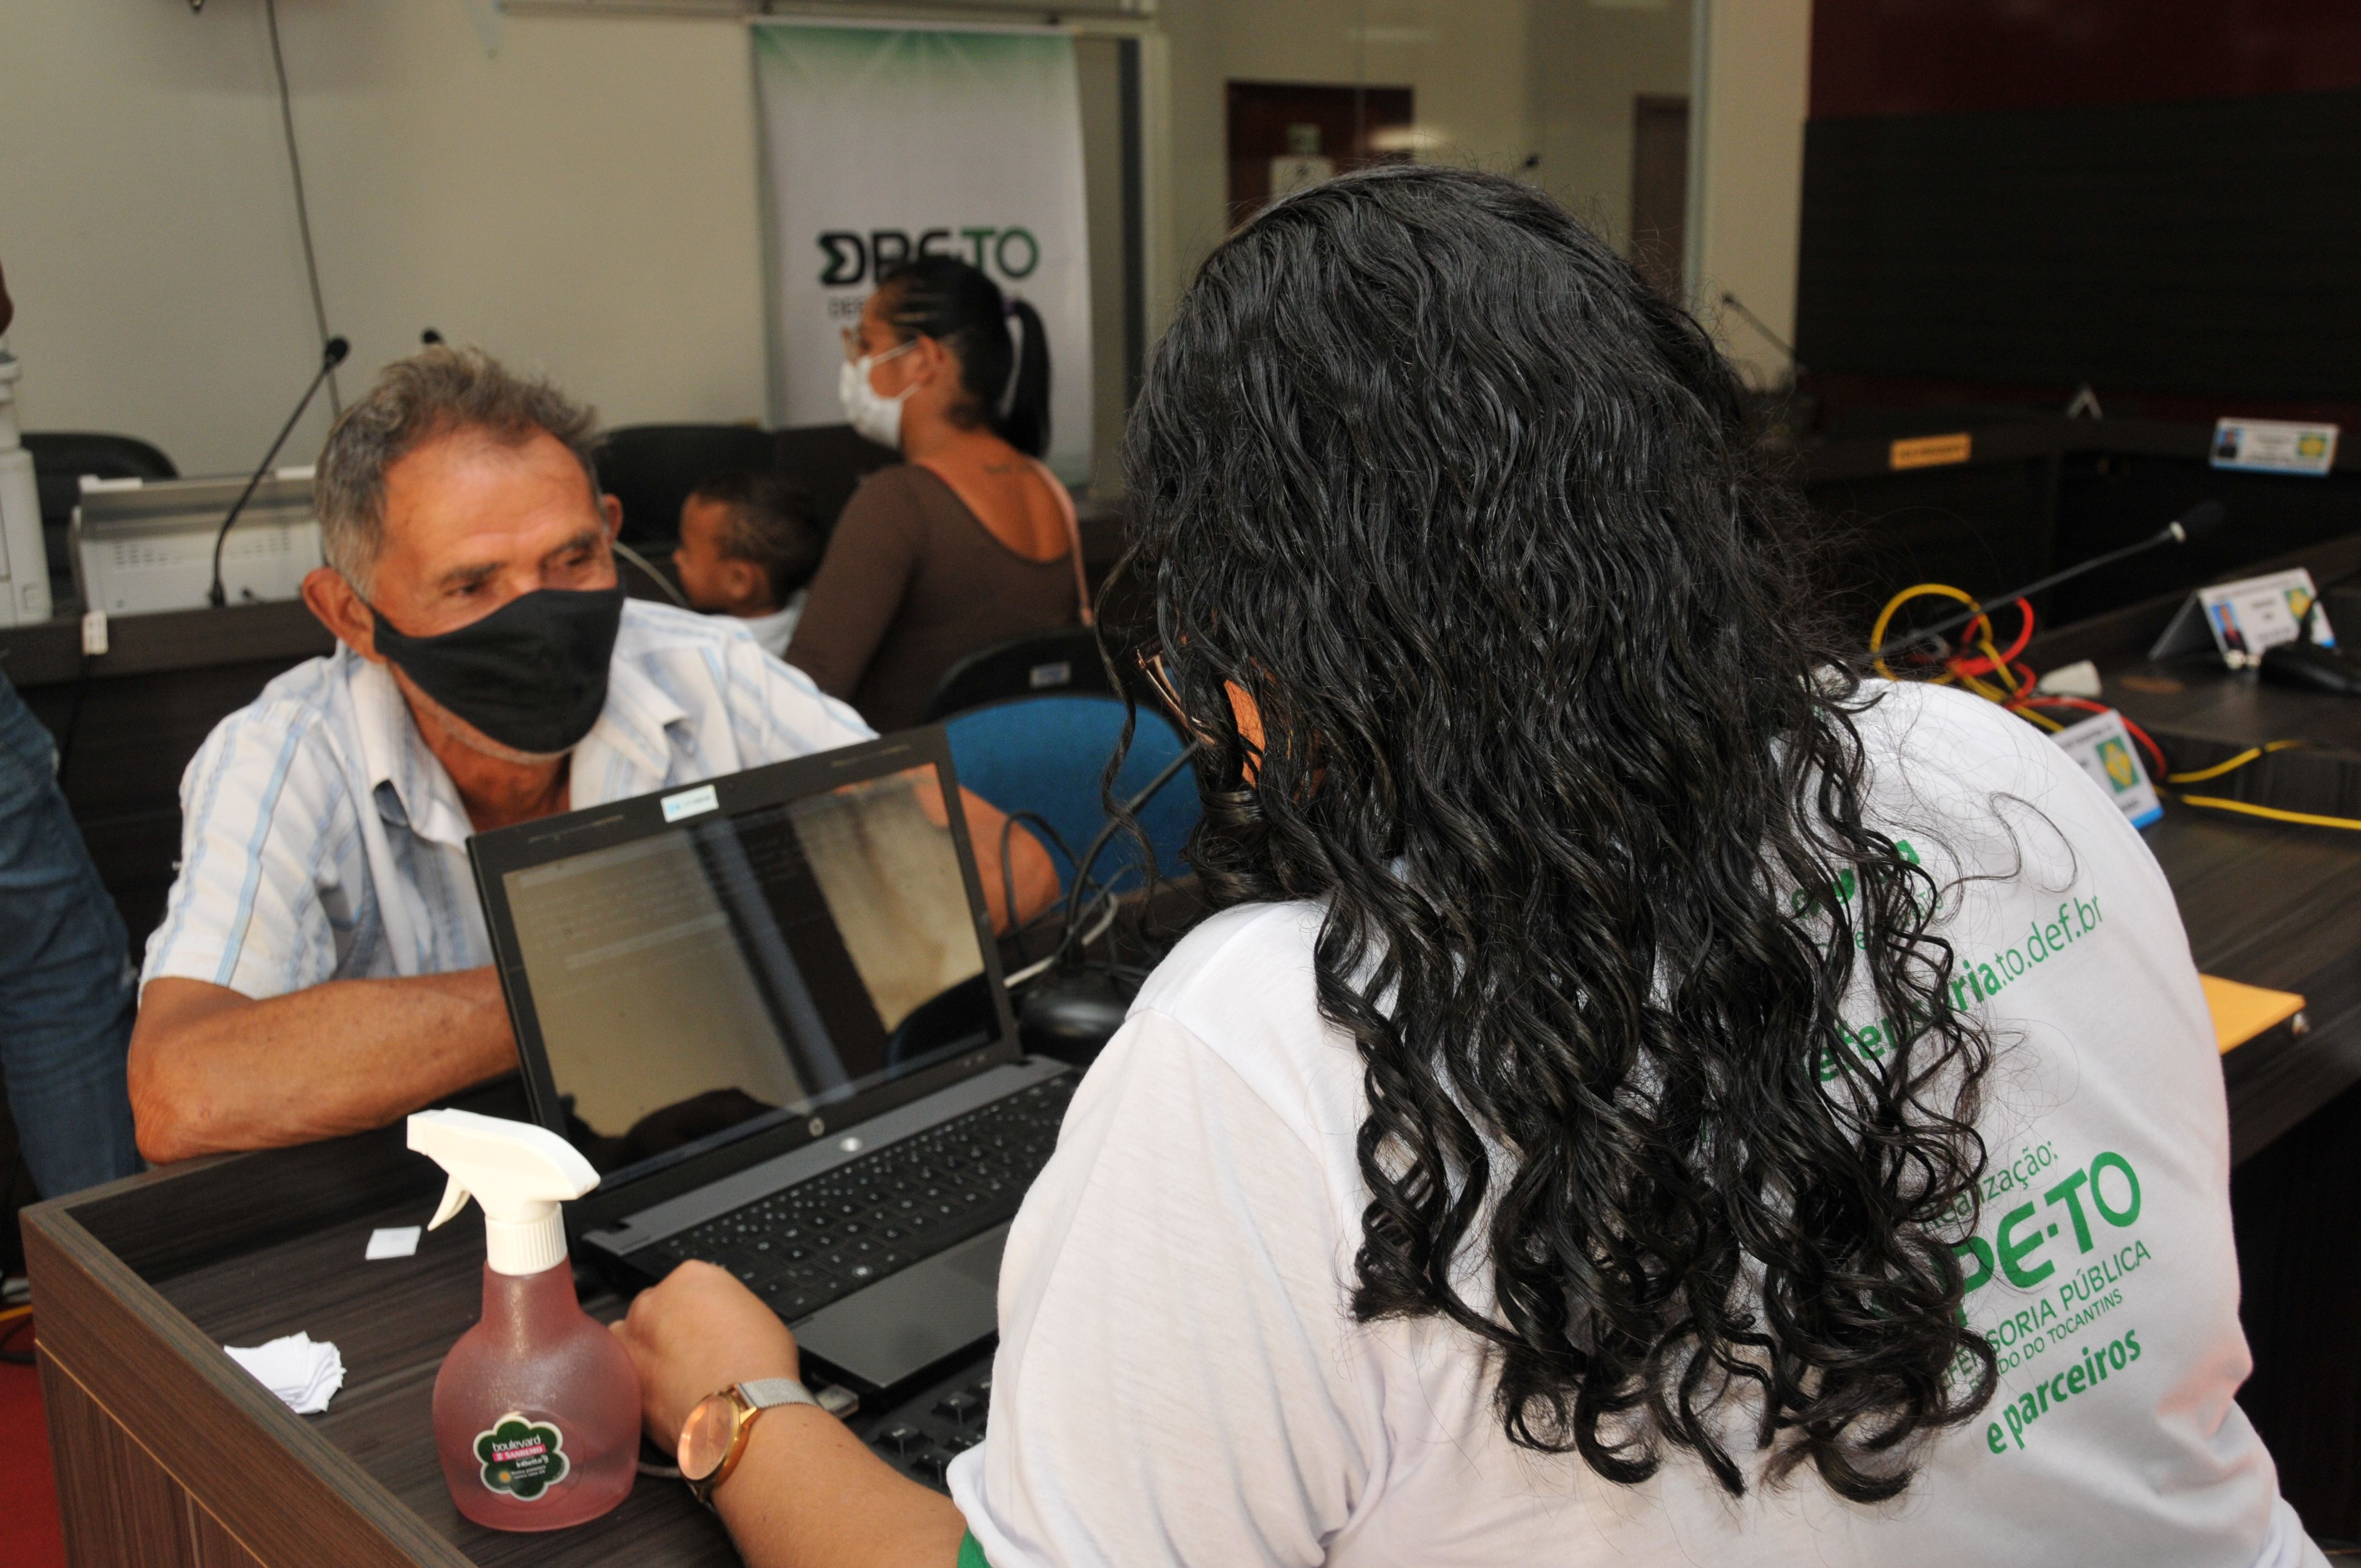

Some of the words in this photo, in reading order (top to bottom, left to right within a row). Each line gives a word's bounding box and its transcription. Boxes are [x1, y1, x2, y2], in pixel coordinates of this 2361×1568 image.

[2059, 1239, 2151, 1311] PÚBLICA
[2023, 1337, 2045, 1360] DO
[2047, 1289, 2123, 1344] TOCANTINS
[1987, 1421, 2008, 1455] e
[2003, 1329, 2142, 1450] parceiros
[492, 1433, 541, 1452] boulevard
[505, 1445, 543, 1460] SANREMO
